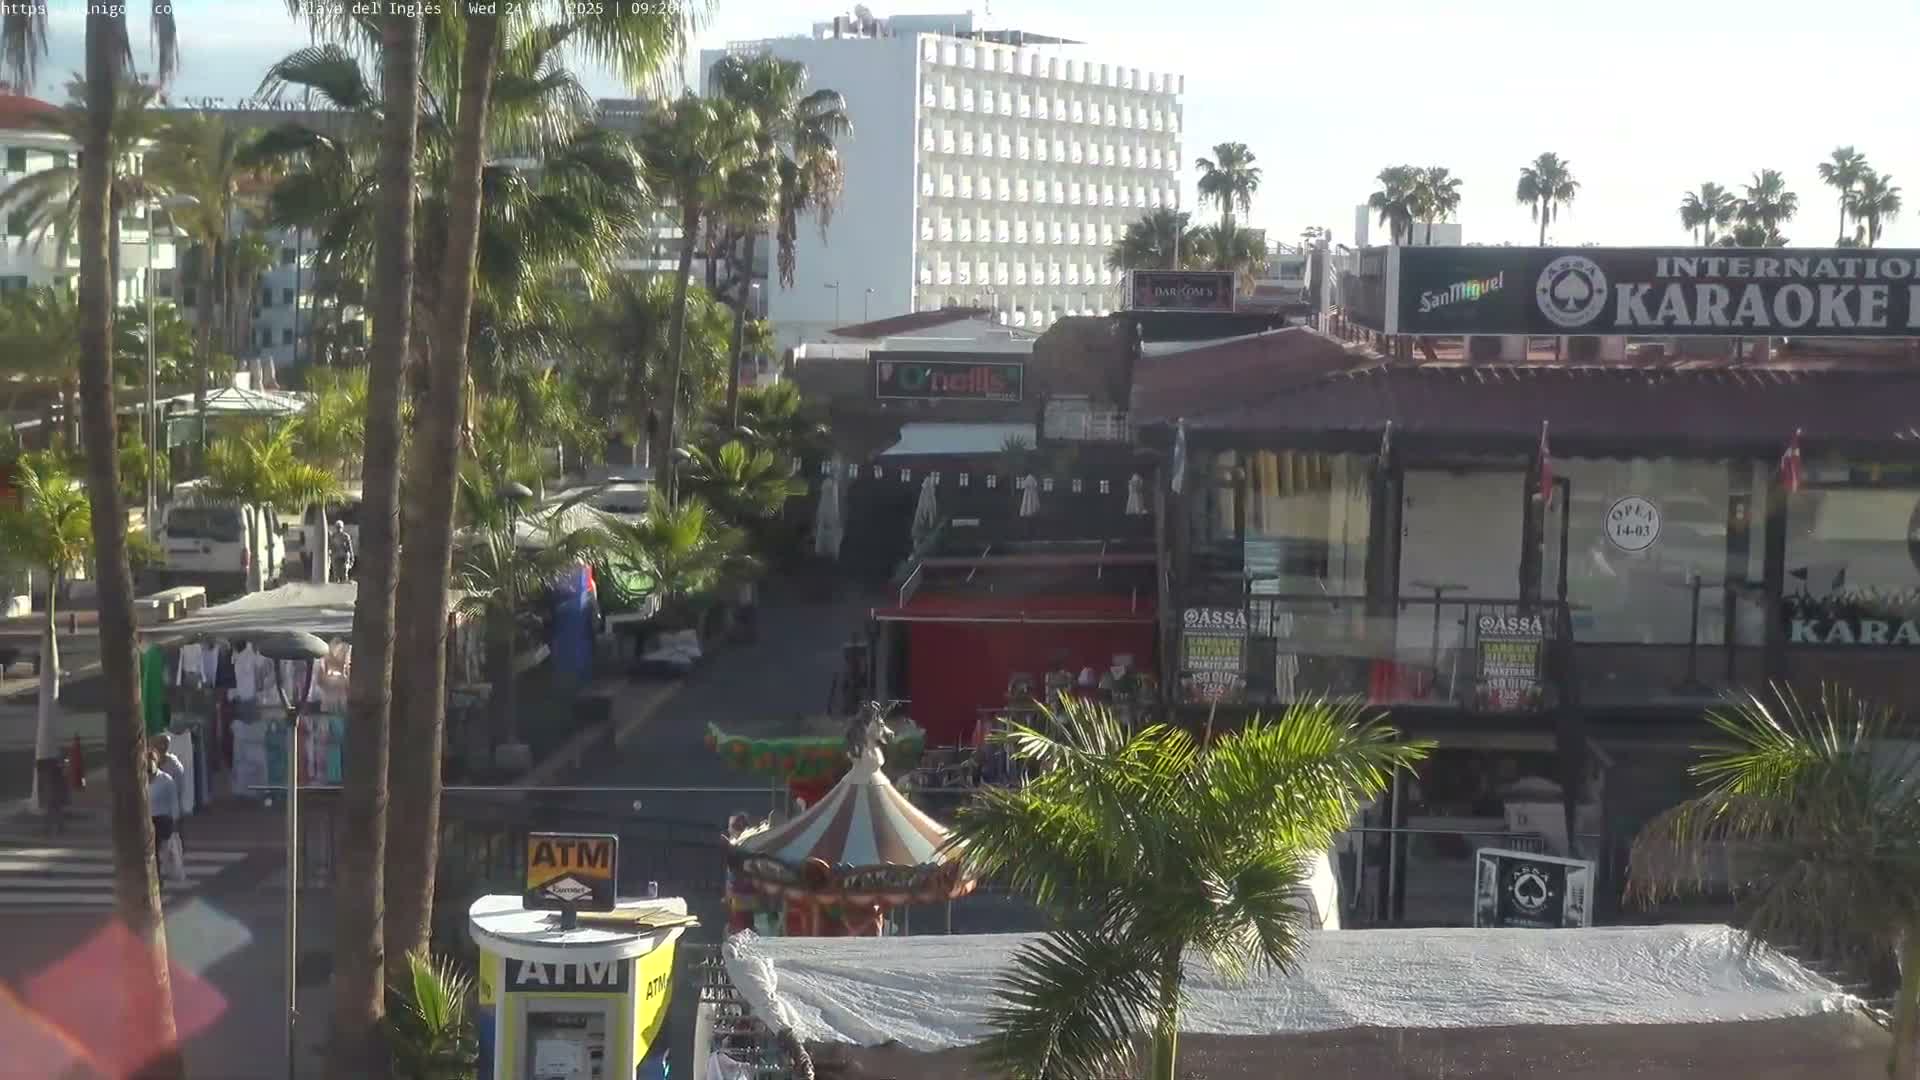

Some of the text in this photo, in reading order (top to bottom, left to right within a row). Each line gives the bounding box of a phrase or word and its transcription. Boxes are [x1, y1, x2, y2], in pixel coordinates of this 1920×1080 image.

[1656, 256, 1920, 278] INTERNATIO
[1614, 283, 1888, 327] KARAOKE
[1198, 608, 1247, 624] ÄSSÄ
[531, 841, 611, 869] ATM
[515, 959, 618, 985] ATM
[646, 972, 667, 1001] ATM
